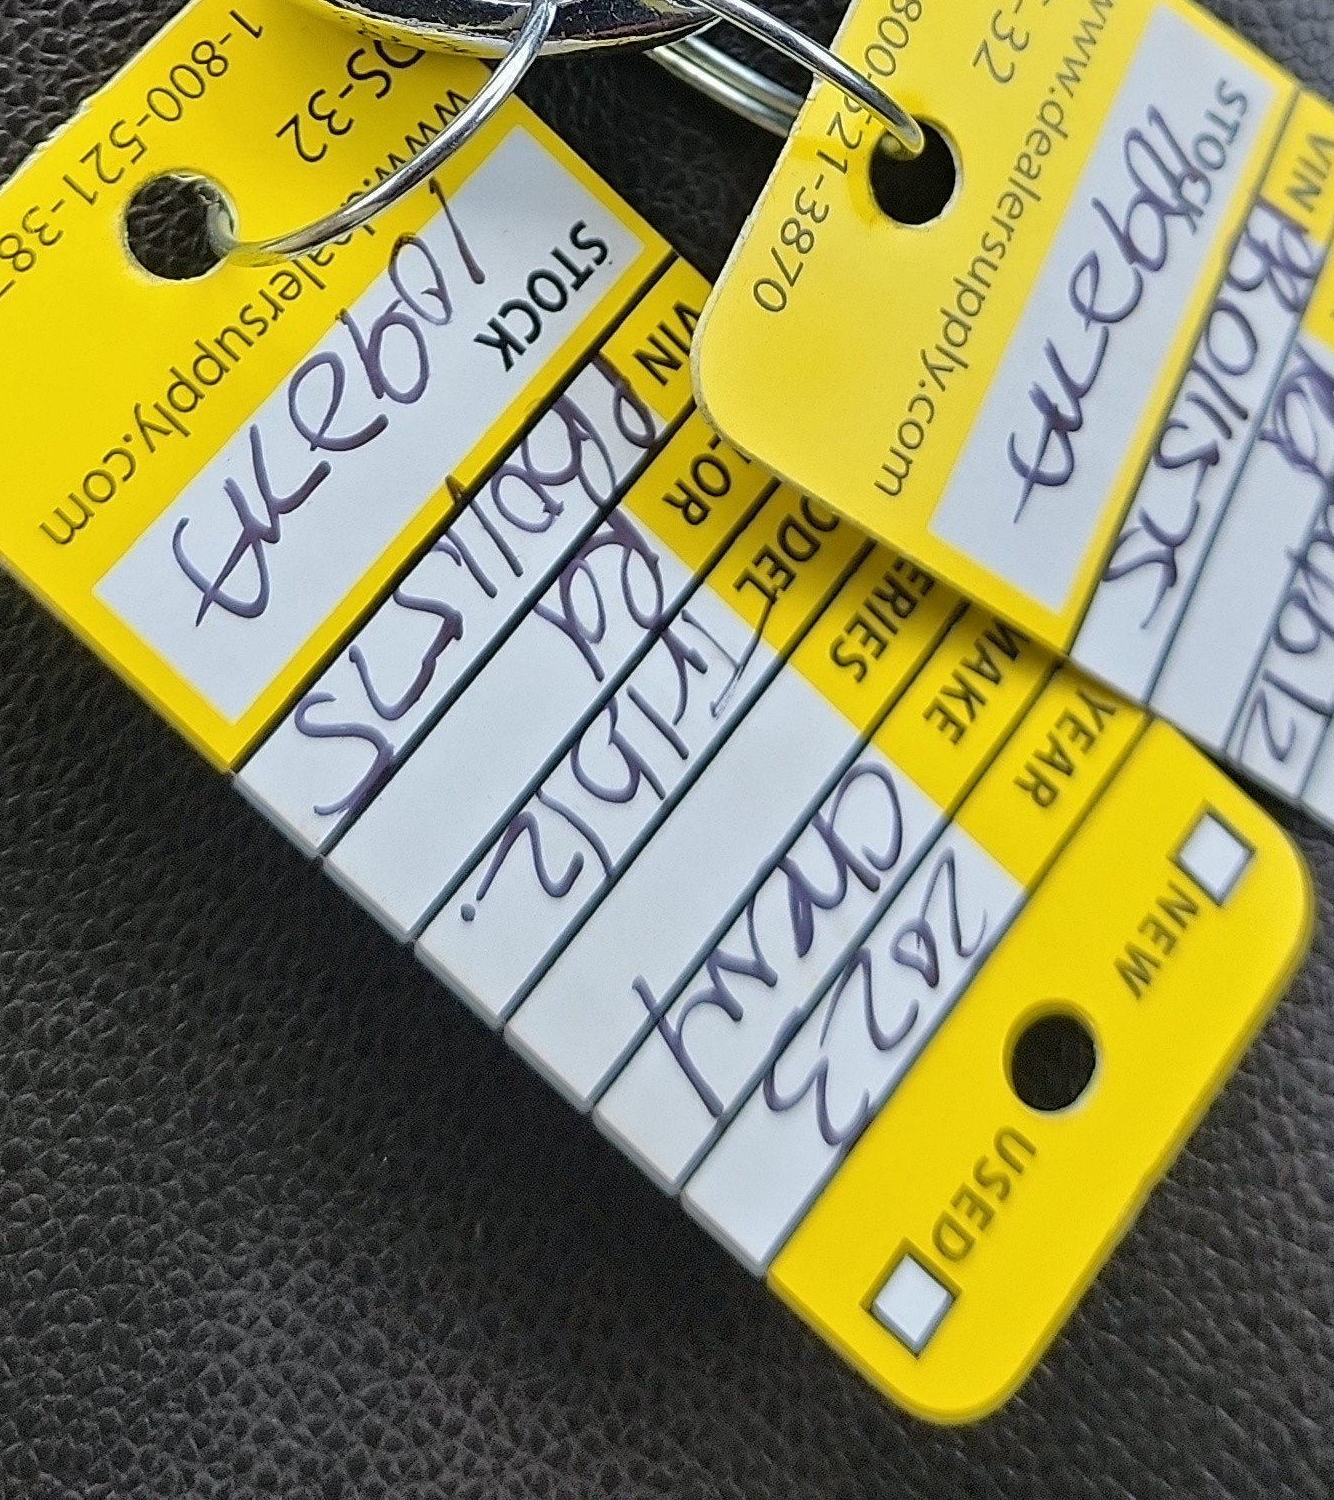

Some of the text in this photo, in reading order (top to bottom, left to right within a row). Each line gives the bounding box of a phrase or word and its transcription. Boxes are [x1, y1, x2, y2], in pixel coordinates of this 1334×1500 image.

[1173, 78, 1249, 237] STOCK
[38, 90, 470, 545] www.alersupply.com
[472, 223, 610, 372] STOCK
[632, 301, 698, 386] VIN
[662, 440, 751, 526] LOR
[733, 496, 839, 602] ODEL
[829, 557, 936, 682] ERIES
[923, 618, 1031, 746] MAKE
[1014, 688, 1115, 809] YEAR
[764, 845, 987, 1147] 2023
[930, 880, 1200, 1263] NEW USED
